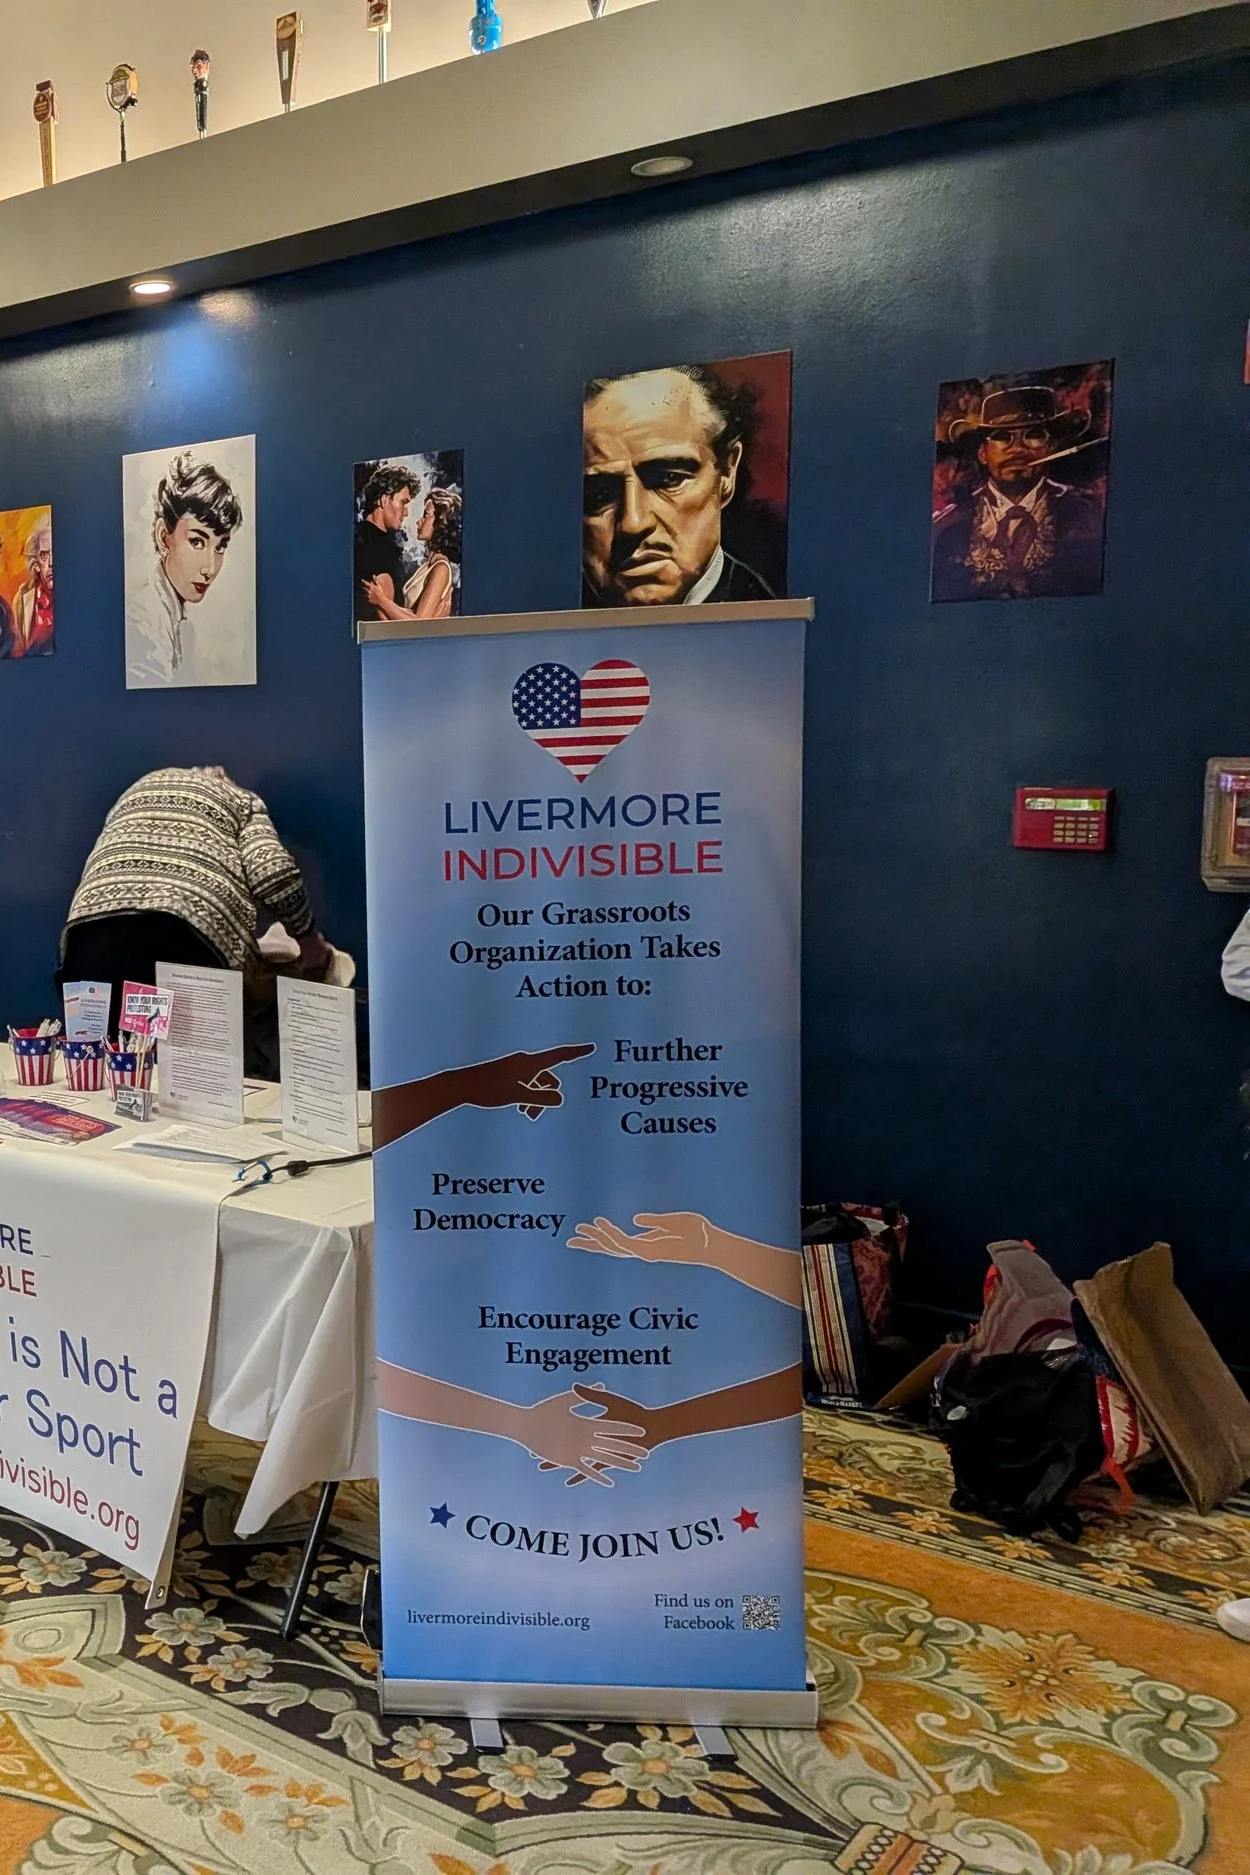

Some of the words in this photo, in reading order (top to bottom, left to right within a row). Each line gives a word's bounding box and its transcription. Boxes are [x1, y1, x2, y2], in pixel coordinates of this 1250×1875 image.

[445, 791, 722, 834] LIVERMORE
[443, 840, 724, 881] INDIVISIBLE
[477, 903, 534, 927] Our
[541, 900, 691, 925] Grassroots
[450, 939, 632, 970] Organization
[640, 935, 721, 959] Takes
[516, 974, 608, 998] Action
[616, 976, 652, 996] to:
[614, 1037, 723, 1062] Further
[590, 1075, 749, 1105] Progressive
[620, 1111, 717, 1135] Causes
[431, 1173, 545, 1196] Preserve
[413, 1208, 566, 1237] Democracy
[478, 1306, 621, 1336] Encourage
[628, 1306, 699, 1330] Civic
[8, 1315, 42, 1370] is
[60, 1329, 141, 1403] Not
[157, 1379, 178, 1419] a
[505, 1342, 672, 1371] Engagement
[26, 1388, 144, 1477] Sport
[465, 1514, 569, 1557] COME
[578, 1530, 659, 1563] JOIN
[669, 1517, 725, 1551] US!
[654, 1593, 688, 1608] Find
[693, 1597, 711, 1609] us
[714, 1598, 735, 1609] on
[407, 1609, 590, 1631] livermoreindivisible.org
[664, 1614, 736, 1631] Facebook
